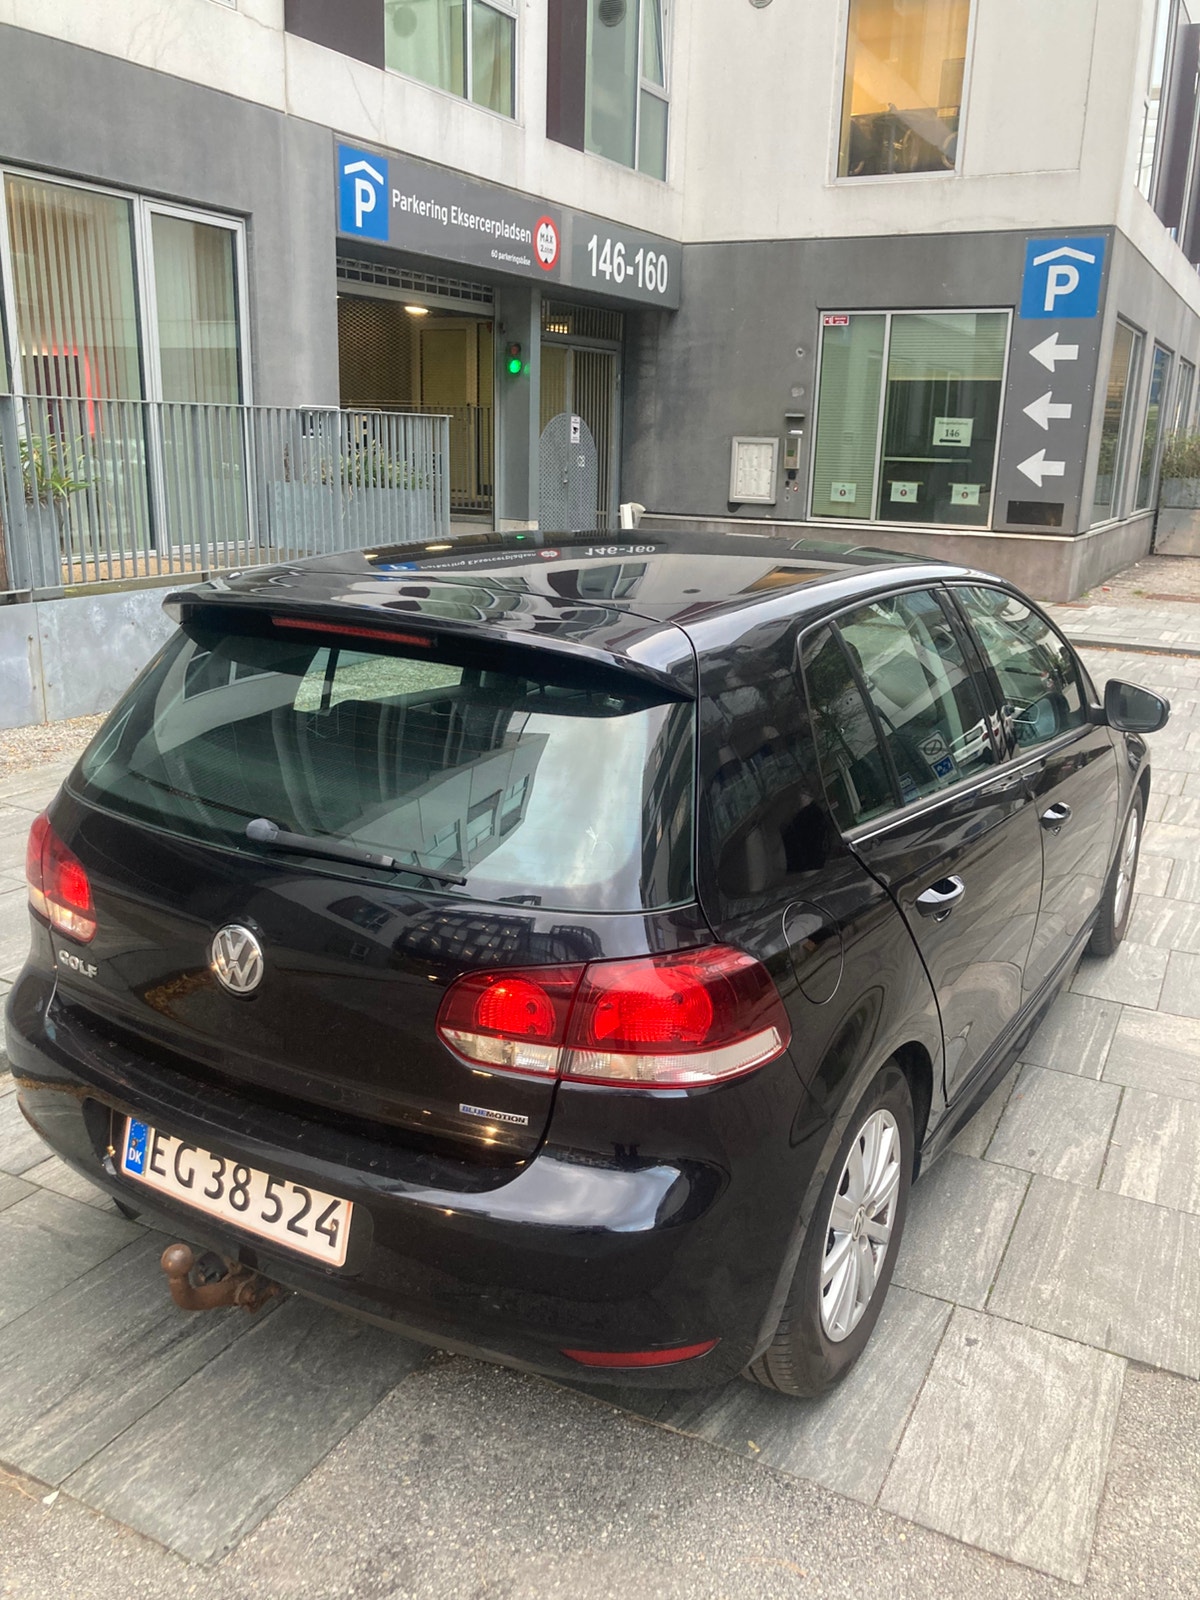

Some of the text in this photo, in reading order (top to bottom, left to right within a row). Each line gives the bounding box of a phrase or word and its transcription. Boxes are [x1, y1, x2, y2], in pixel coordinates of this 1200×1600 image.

[355, 178, 377, 228] P
[392, 189, 532, 244] Parkering Eksercerpladsen
[540, 233, 553, 243] MAX
[491, 249, 498, 259] 60
[587, 234, 668, 294] 146-160
[1044, 265, 1080, 312] P
[944, 428, 960, 437] 146
[58, 949, 100, 979] GOLF
[461, 1105, 526, 1124] BLUEMOTION
[128, 1149, 142, 1165] DK
[149, 1129, 342, 1249] EG 38 524
